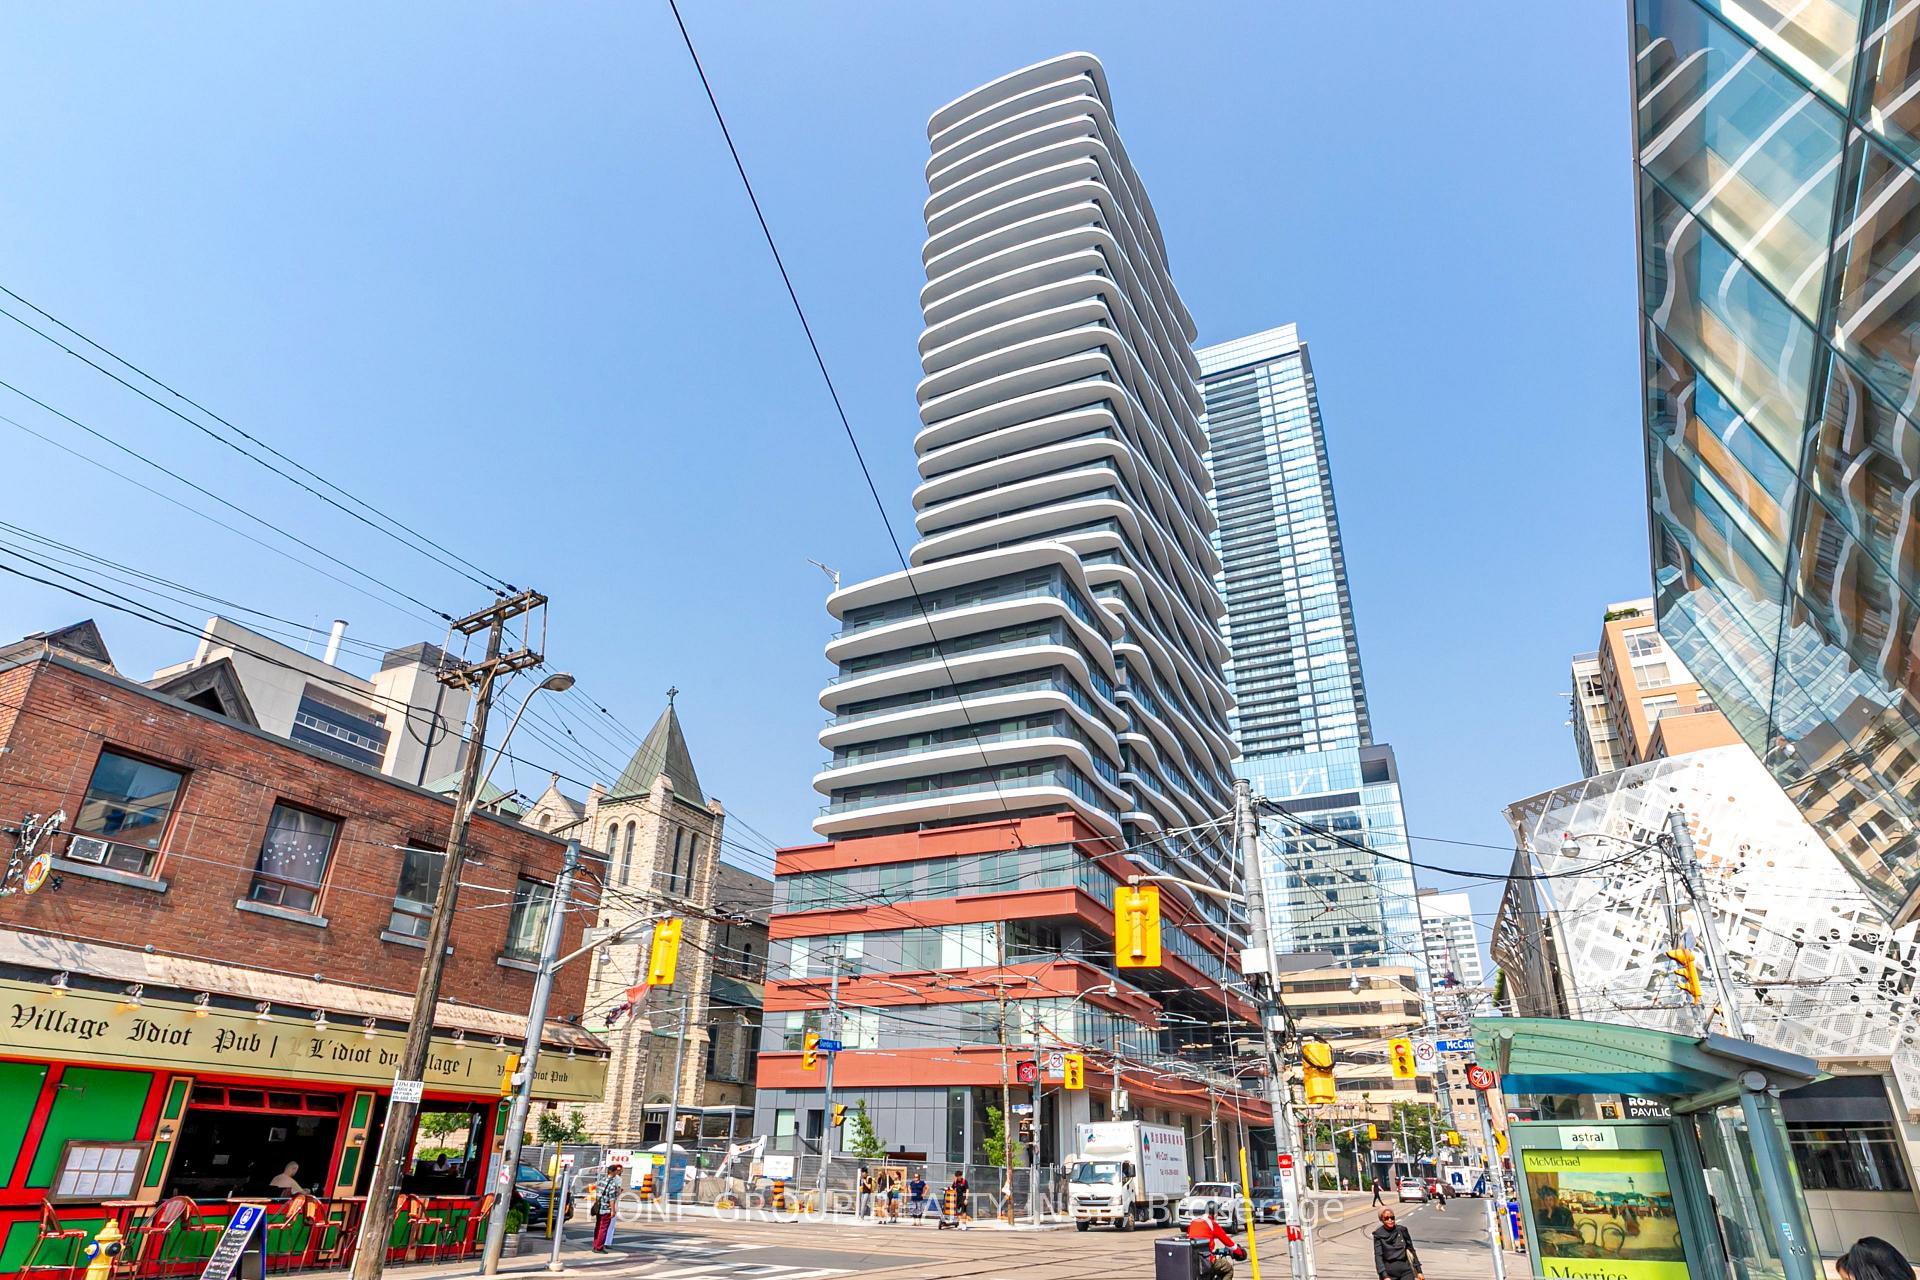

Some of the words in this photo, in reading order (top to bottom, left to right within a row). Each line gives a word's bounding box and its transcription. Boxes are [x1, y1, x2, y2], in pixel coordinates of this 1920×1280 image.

[11, 1003, 110, 1041] Village
[126, 1018, 194, 1047] Idiot
[211, 1028, 261, 1054] Pub
[550, 1070, 568, 1083] Pub
[1628, 1096, 1659, 1106] ROS
[1571, 1132, 1604, 1142] astral
[611, 1155, 630, 1163] NO
[1529, 1156, 1581, 1167] McMichael
